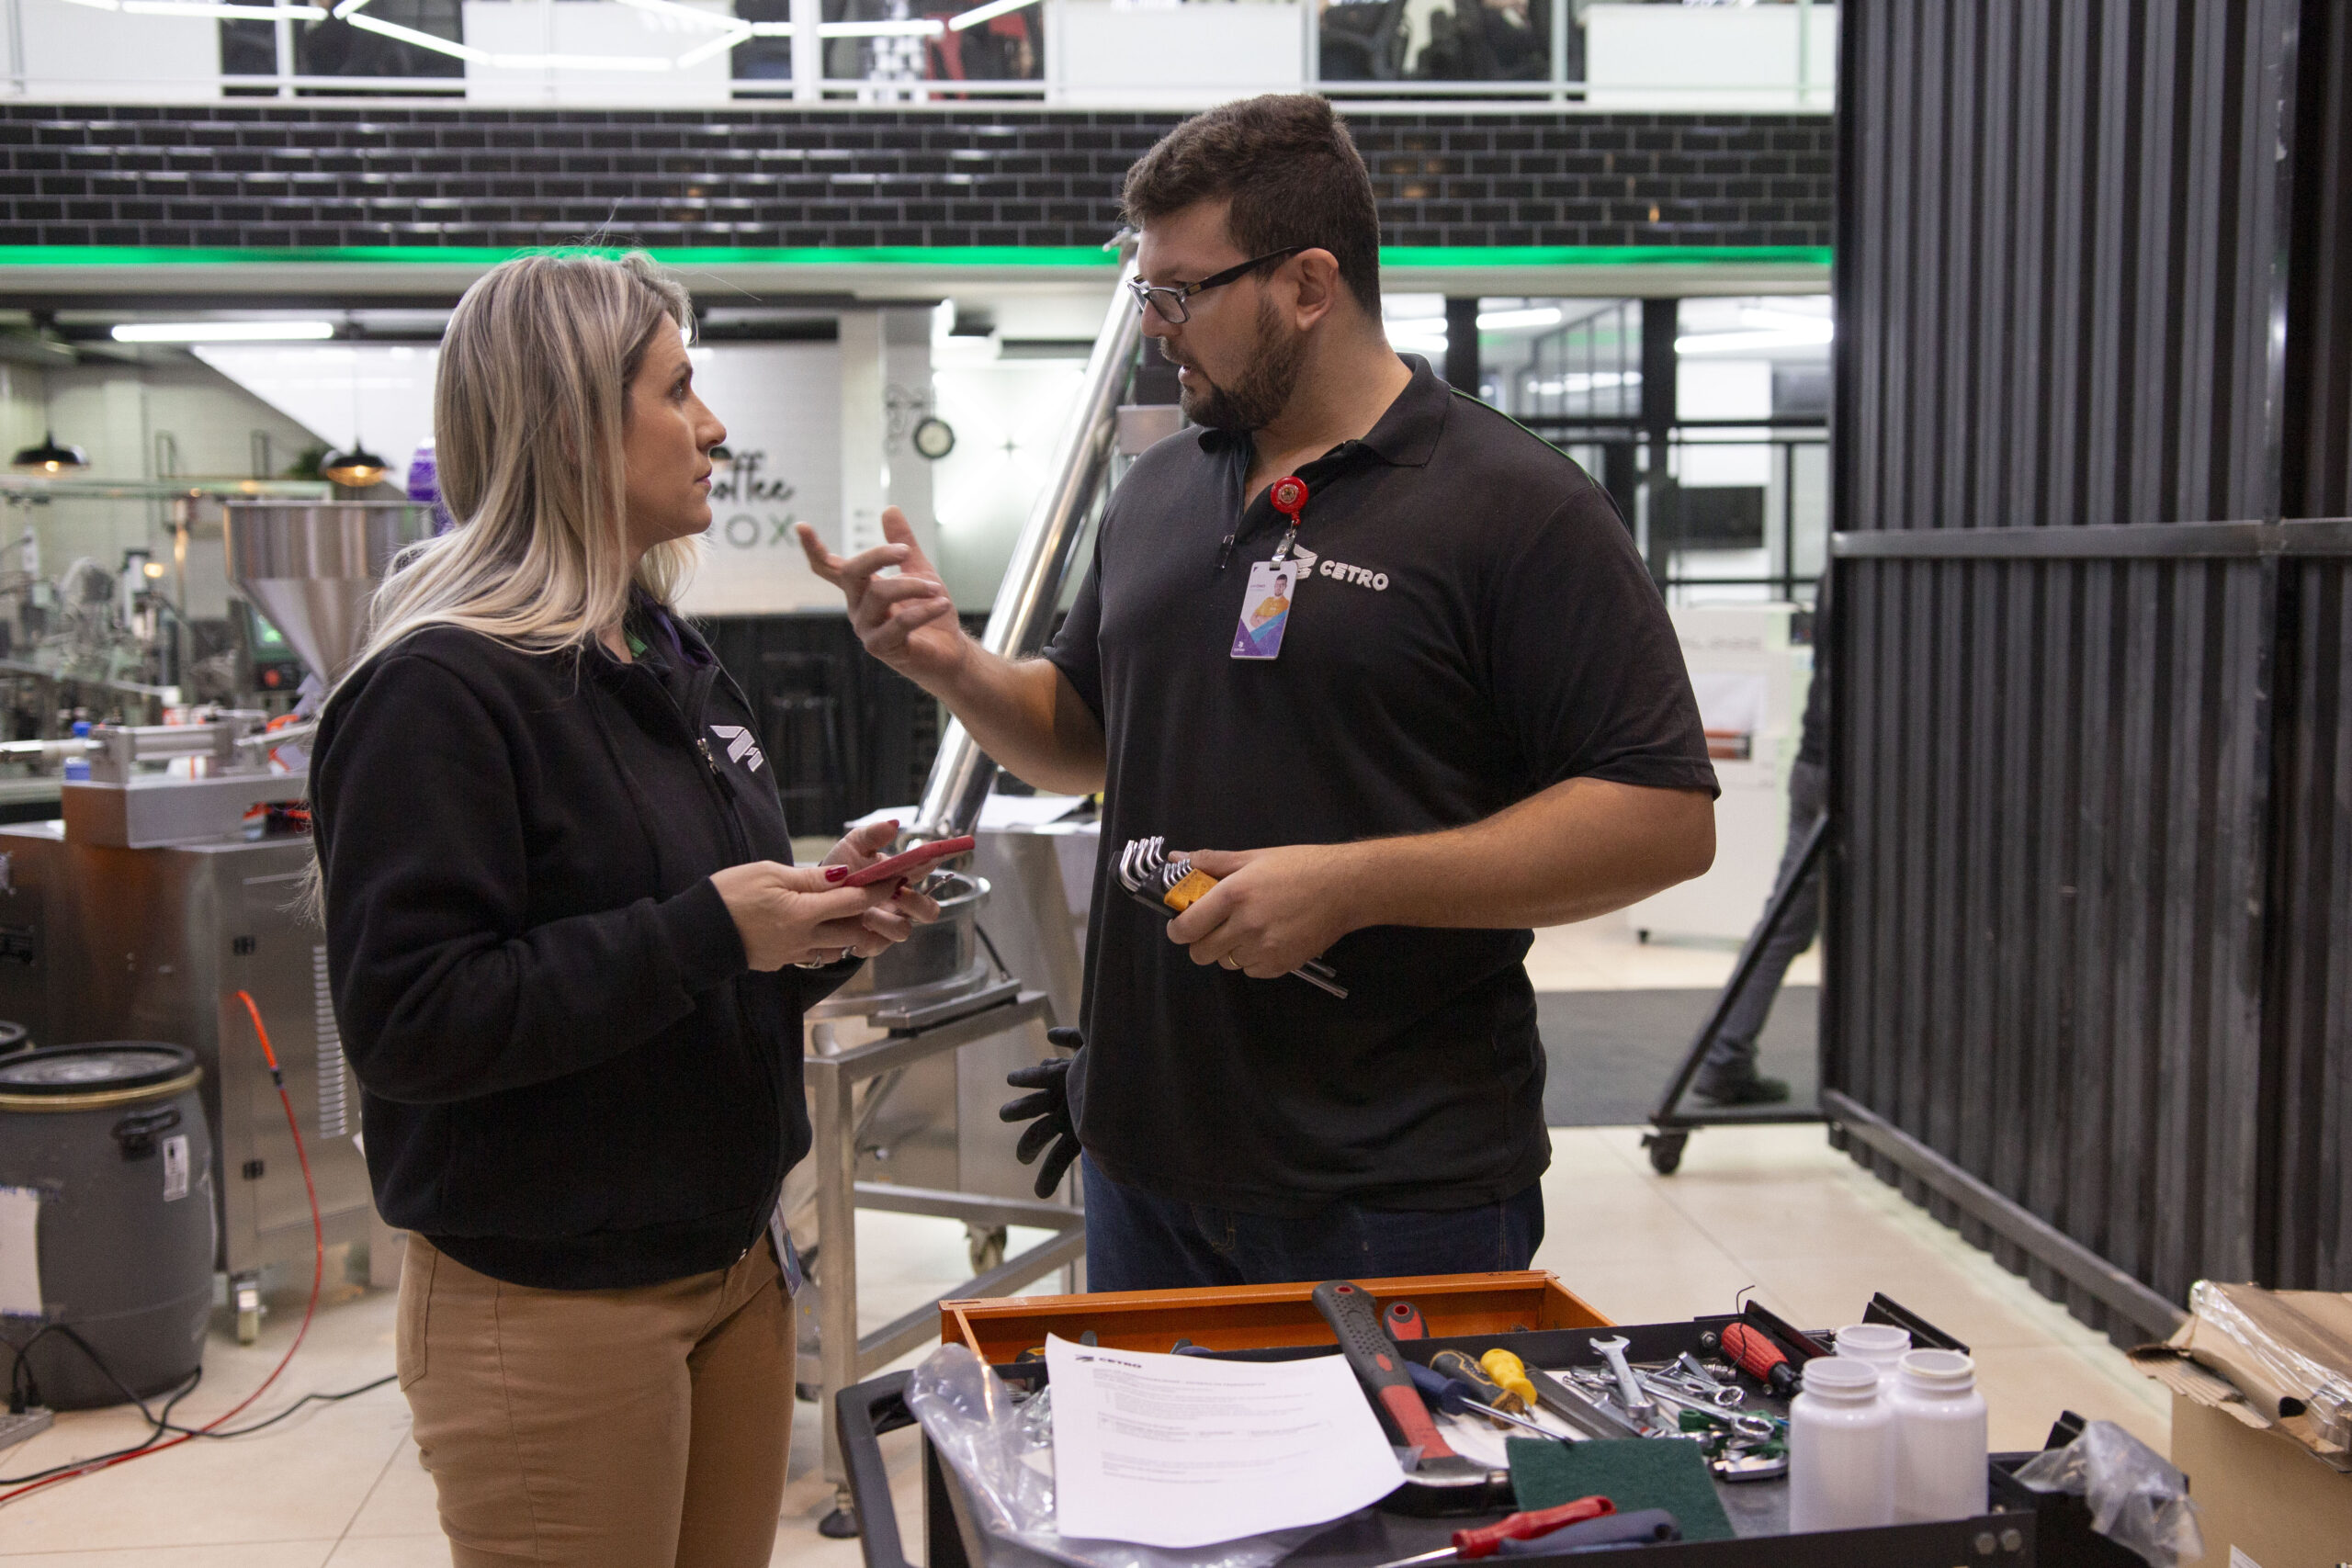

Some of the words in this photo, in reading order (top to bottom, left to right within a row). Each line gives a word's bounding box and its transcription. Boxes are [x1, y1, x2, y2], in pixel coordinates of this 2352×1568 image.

[710, 450, 796, 502] offee
[725, 513, 797, 549] OX
[1319, 559, 1389, 592] CETRO
